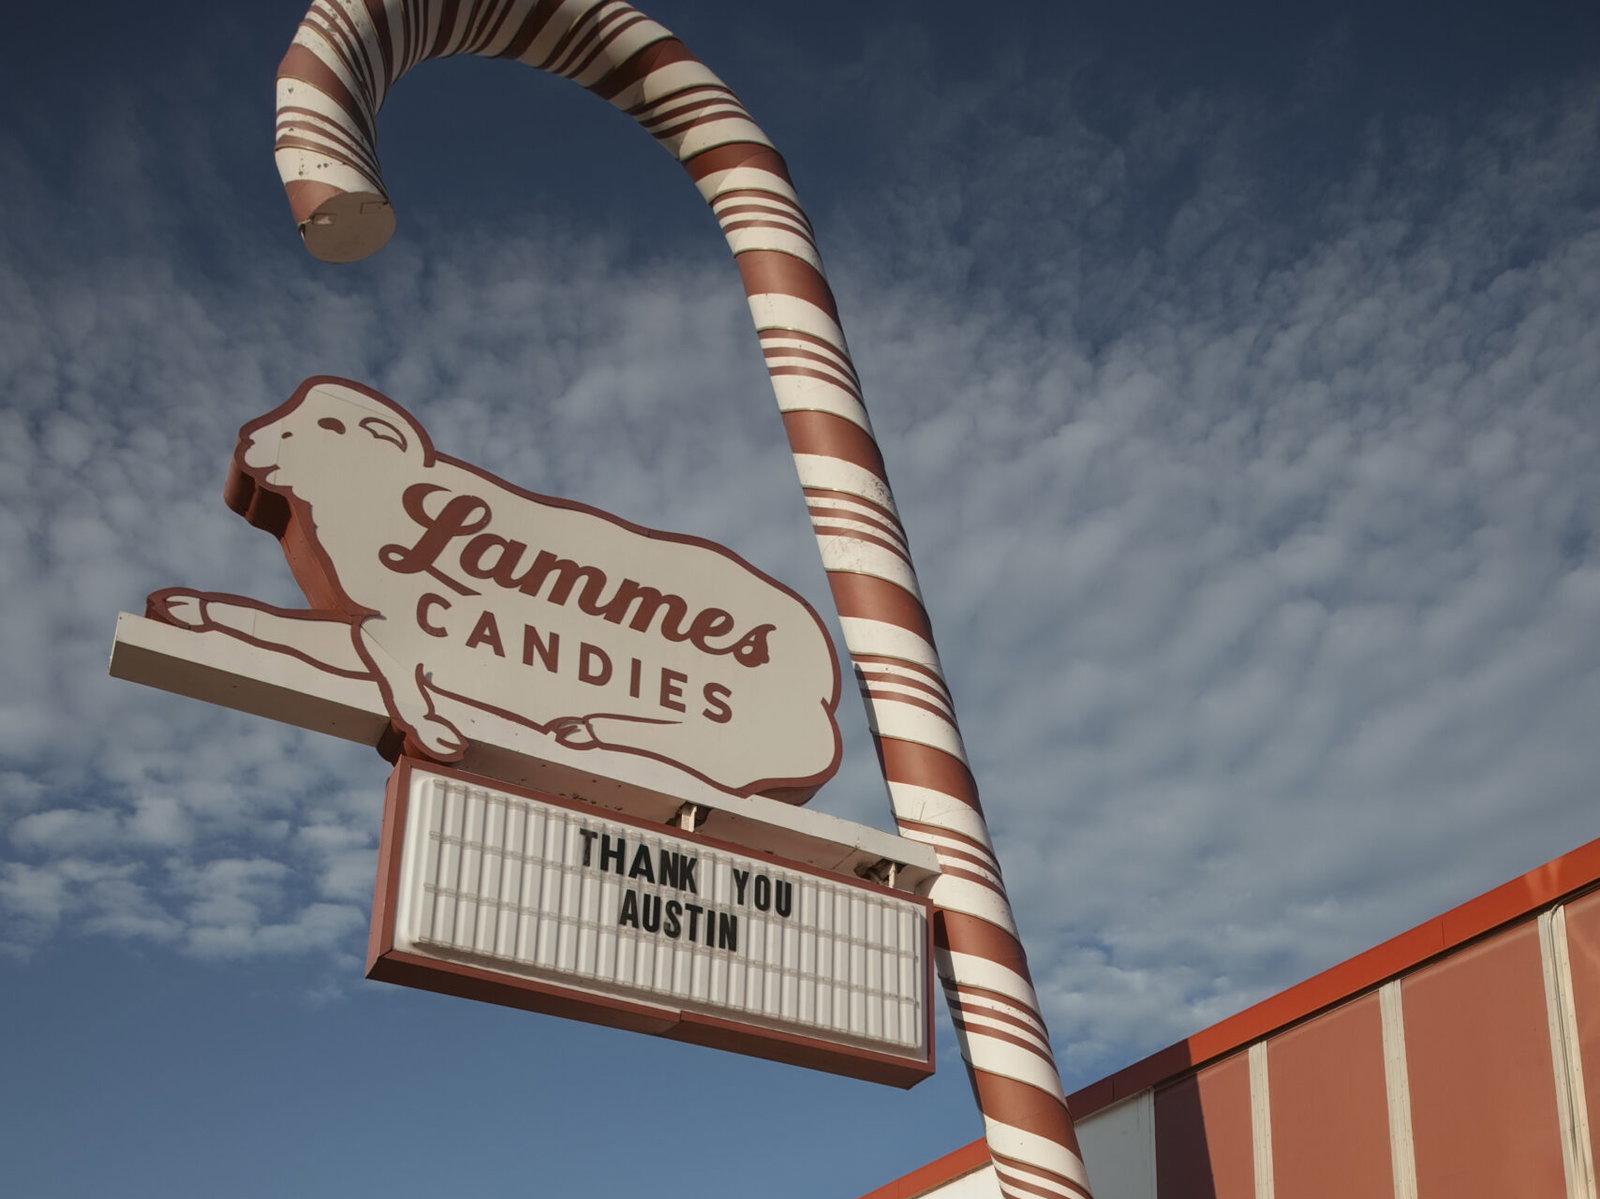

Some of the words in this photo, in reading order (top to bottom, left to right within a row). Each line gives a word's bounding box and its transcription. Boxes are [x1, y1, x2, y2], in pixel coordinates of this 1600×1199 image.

[379, 482, 776, 667] Lammes
[416, 593, 733, 723] CANDIES
[579, 828, 698, 894] THANK
[732, 868, 793, 918] YOU
[619, 889, 738, 952] AUSTIN
